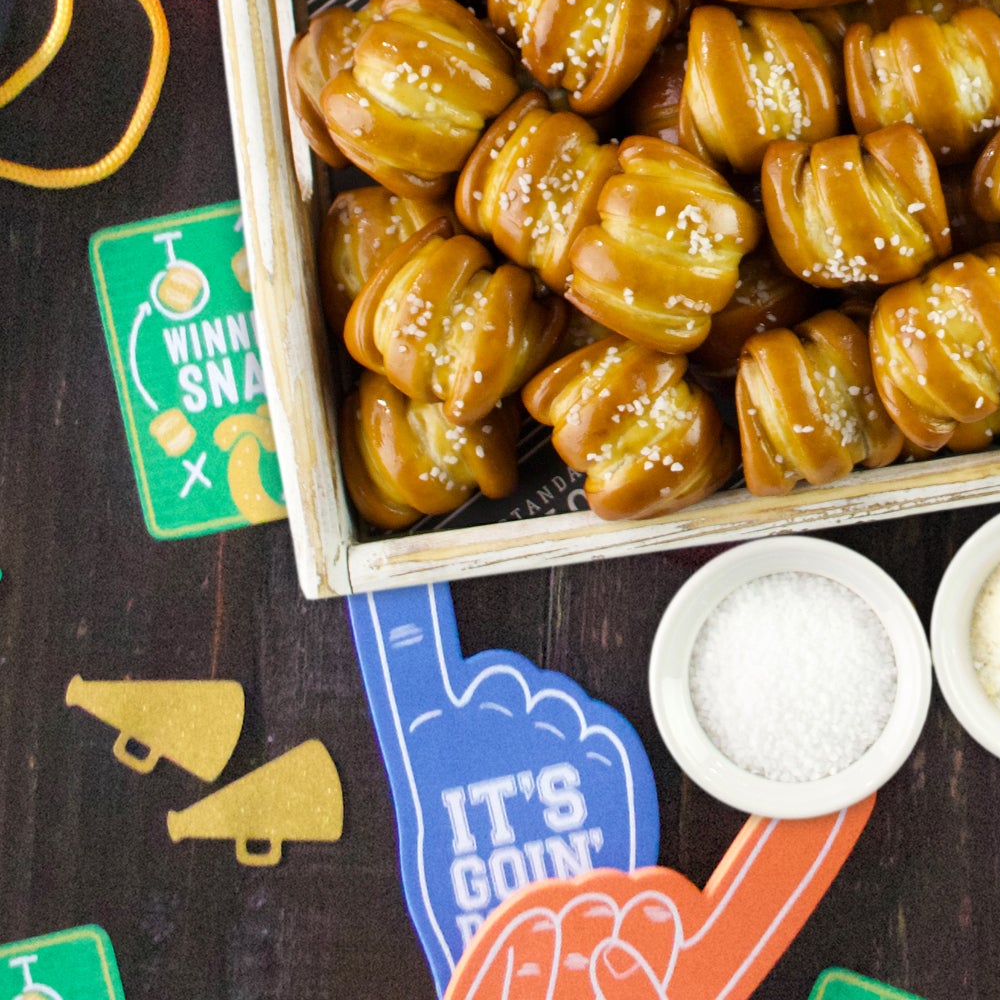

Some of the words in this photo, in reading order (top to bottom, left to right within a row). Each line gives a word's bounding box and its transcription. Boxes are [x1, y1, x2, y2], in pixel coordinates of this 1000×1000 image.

[499, 466, 583, 522] TANDA
[441, 762, 588, 856] IT'S
[450, 827, 604, 912] GOIN'
